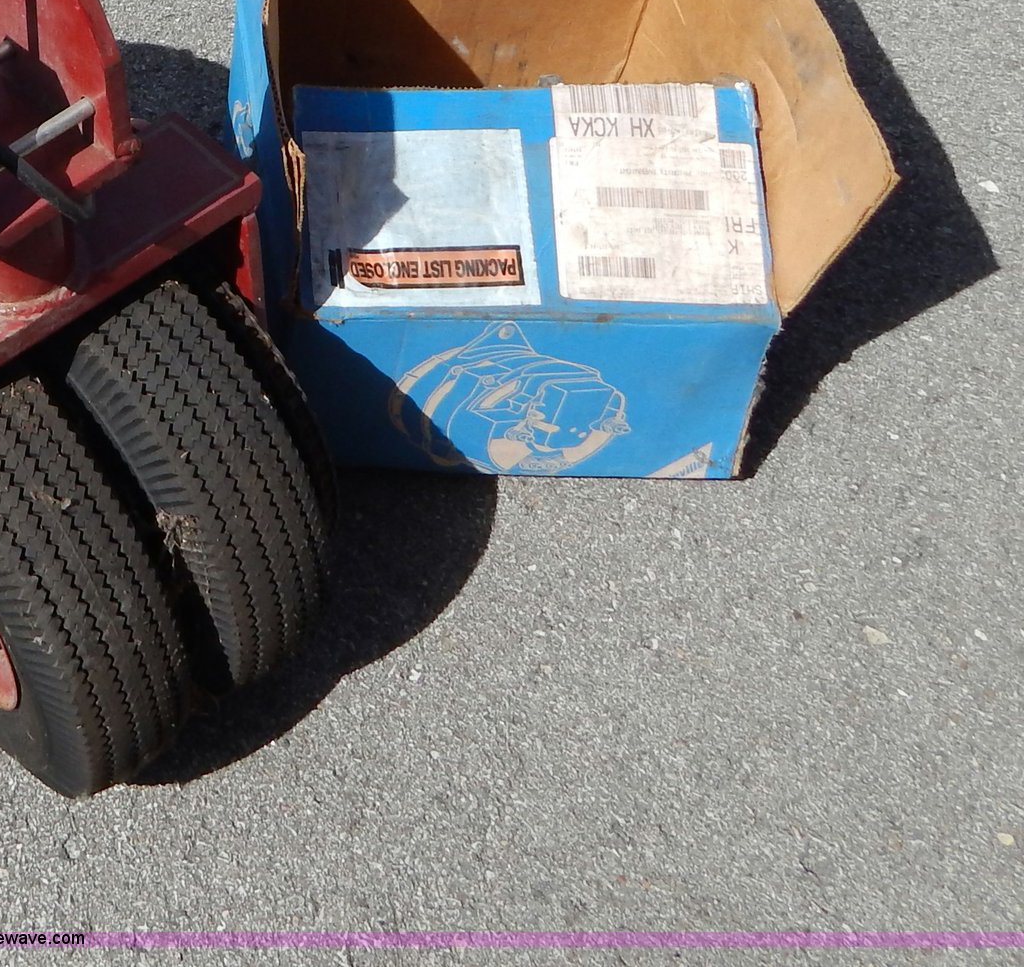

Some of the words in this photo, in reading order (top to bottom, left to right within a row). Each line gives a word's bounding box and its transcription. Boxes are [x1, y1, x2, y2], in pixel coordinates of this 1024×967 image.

[569, 116, 619, 138] KCKA
[630, 117, 655, 138] XH
[725, 216, 757, 234] FRI
[350, 260, 420, 280] ENCLOSED
[422, 259, 452, 279] LIST
[455, 257, 517, 278] PACKING
